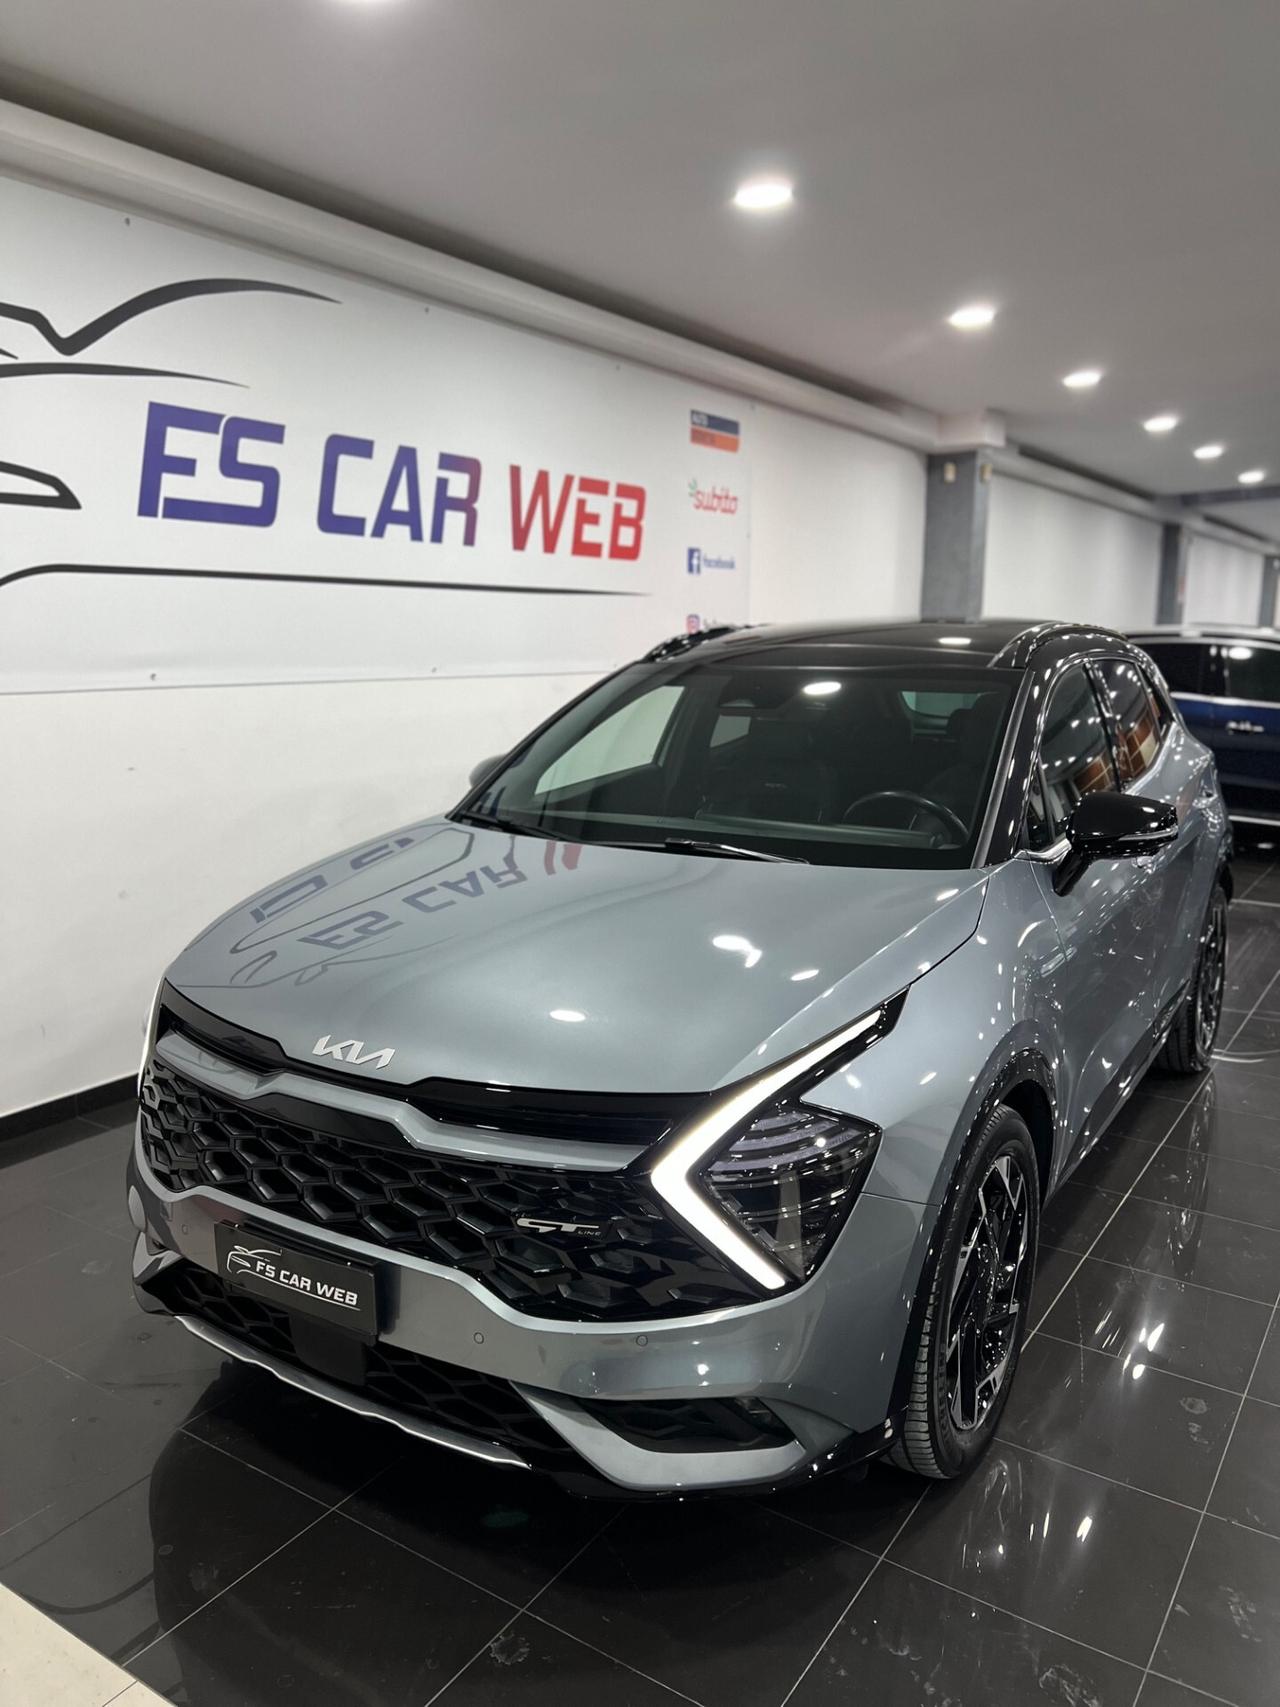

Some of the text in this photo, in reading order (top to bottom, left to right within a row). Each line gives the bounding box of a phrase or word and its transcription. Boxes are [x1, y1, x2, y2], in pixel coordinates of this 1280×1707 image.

[137, 401, 647, 562] FS CAR WEB
[693, 485, 738, 514] subito
[312, 1035, 396, 1070] KIA
[255, 1260, 358, 1306] FS CAR WEB
